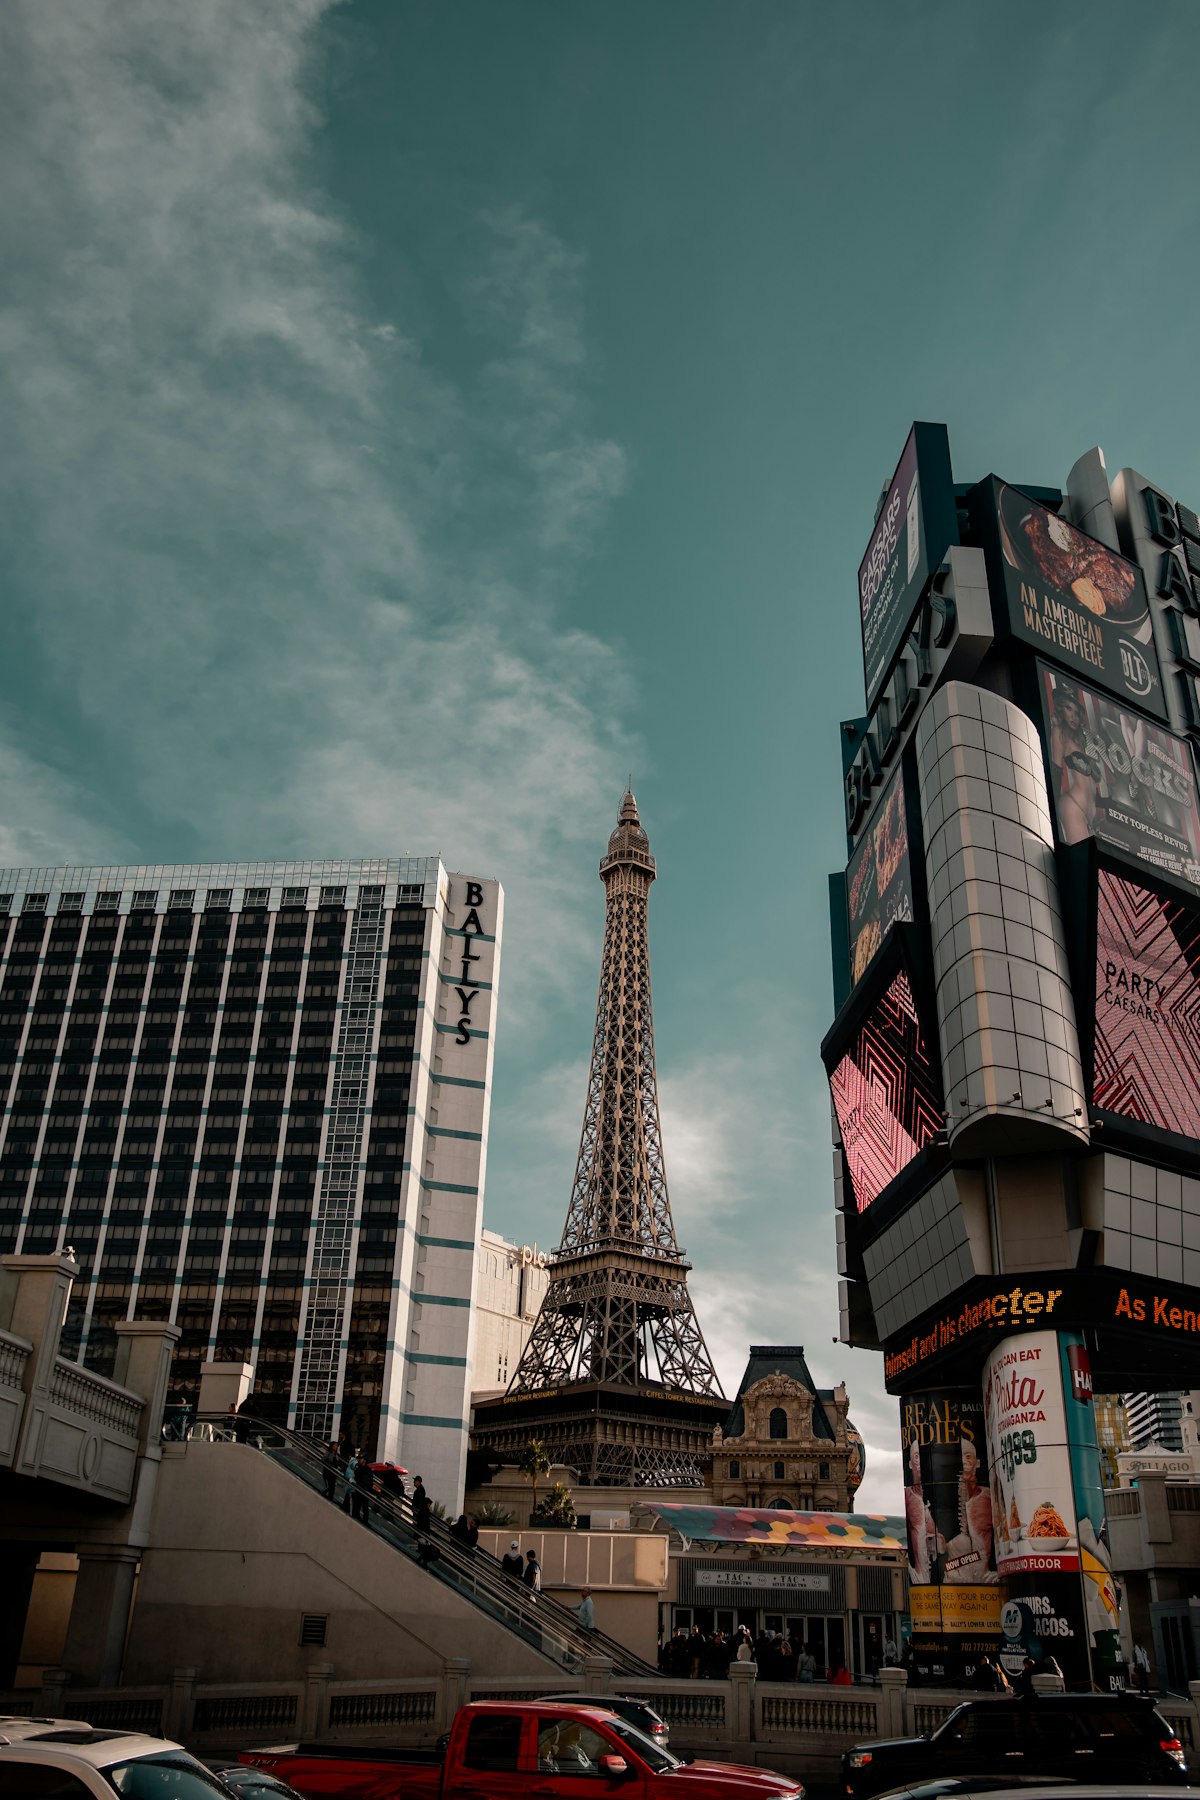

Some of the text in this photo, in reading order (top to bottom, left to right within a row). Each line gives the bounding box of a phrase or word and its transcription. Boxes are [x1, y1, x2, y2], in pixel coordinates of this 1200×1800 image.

[861, 488, 900, 596] CAESARS
[863, 525, 898, 621] SPORTS
[874, 575, 891, 621] SPORTS
[891, 554, 898, 578] ON
[865, 623, 878, 656] YOUR
[878, 583, 894, 629] PHONE
[1021, 582, 1103, 647] AN AMERICAN
[1023, 605, 1104, 670] MASTERPIECE
[1120, 648, 1143, 685] BLT
[1083, 729, 1192, 808] ROCKS
[1108, 808, 1188, 852] SEXY TOPLESS REVUE
[1148, 848, 1160, 858] PLACE
[1150, 856, 1168, 868] FEMALE
[1168, 862, 1182, 872] REVUE
[455, 882, 484, 1045] BALLYS
[1106, 960, 1166, 1001] PARTY
[1105, 990, 1160, 1024] CAESARS
[1114, 1288, 1146, 1320] As
[886, 1288, 1062, 1380] himself and his character
[1004, 1352, 1017, 1367] CAN
[1019, 1349, 1041, 1362] EAT
[532, 1390, 560, 1399] RESTAURANT
[646, 1390, 716, 1406] EIFFEL TOWER RESTAURANT
[995, 1370, 1044, 1416] Pasta
[904, 1400, 960, 1428] REAL
[902, 1420, 975, 1450] BODIES
[1127, 1461, 1190, 1472] BELLAGIO
[945, 1552, 979, 1570] NOW OPEN!
[1030, 1559, 1061, 1568] FLOOR
[925, 1602, 940, 1610] SAME
[942, 1602, 957, 1610] WAY
[960, 1602, 988, 1610] AGAIN!
